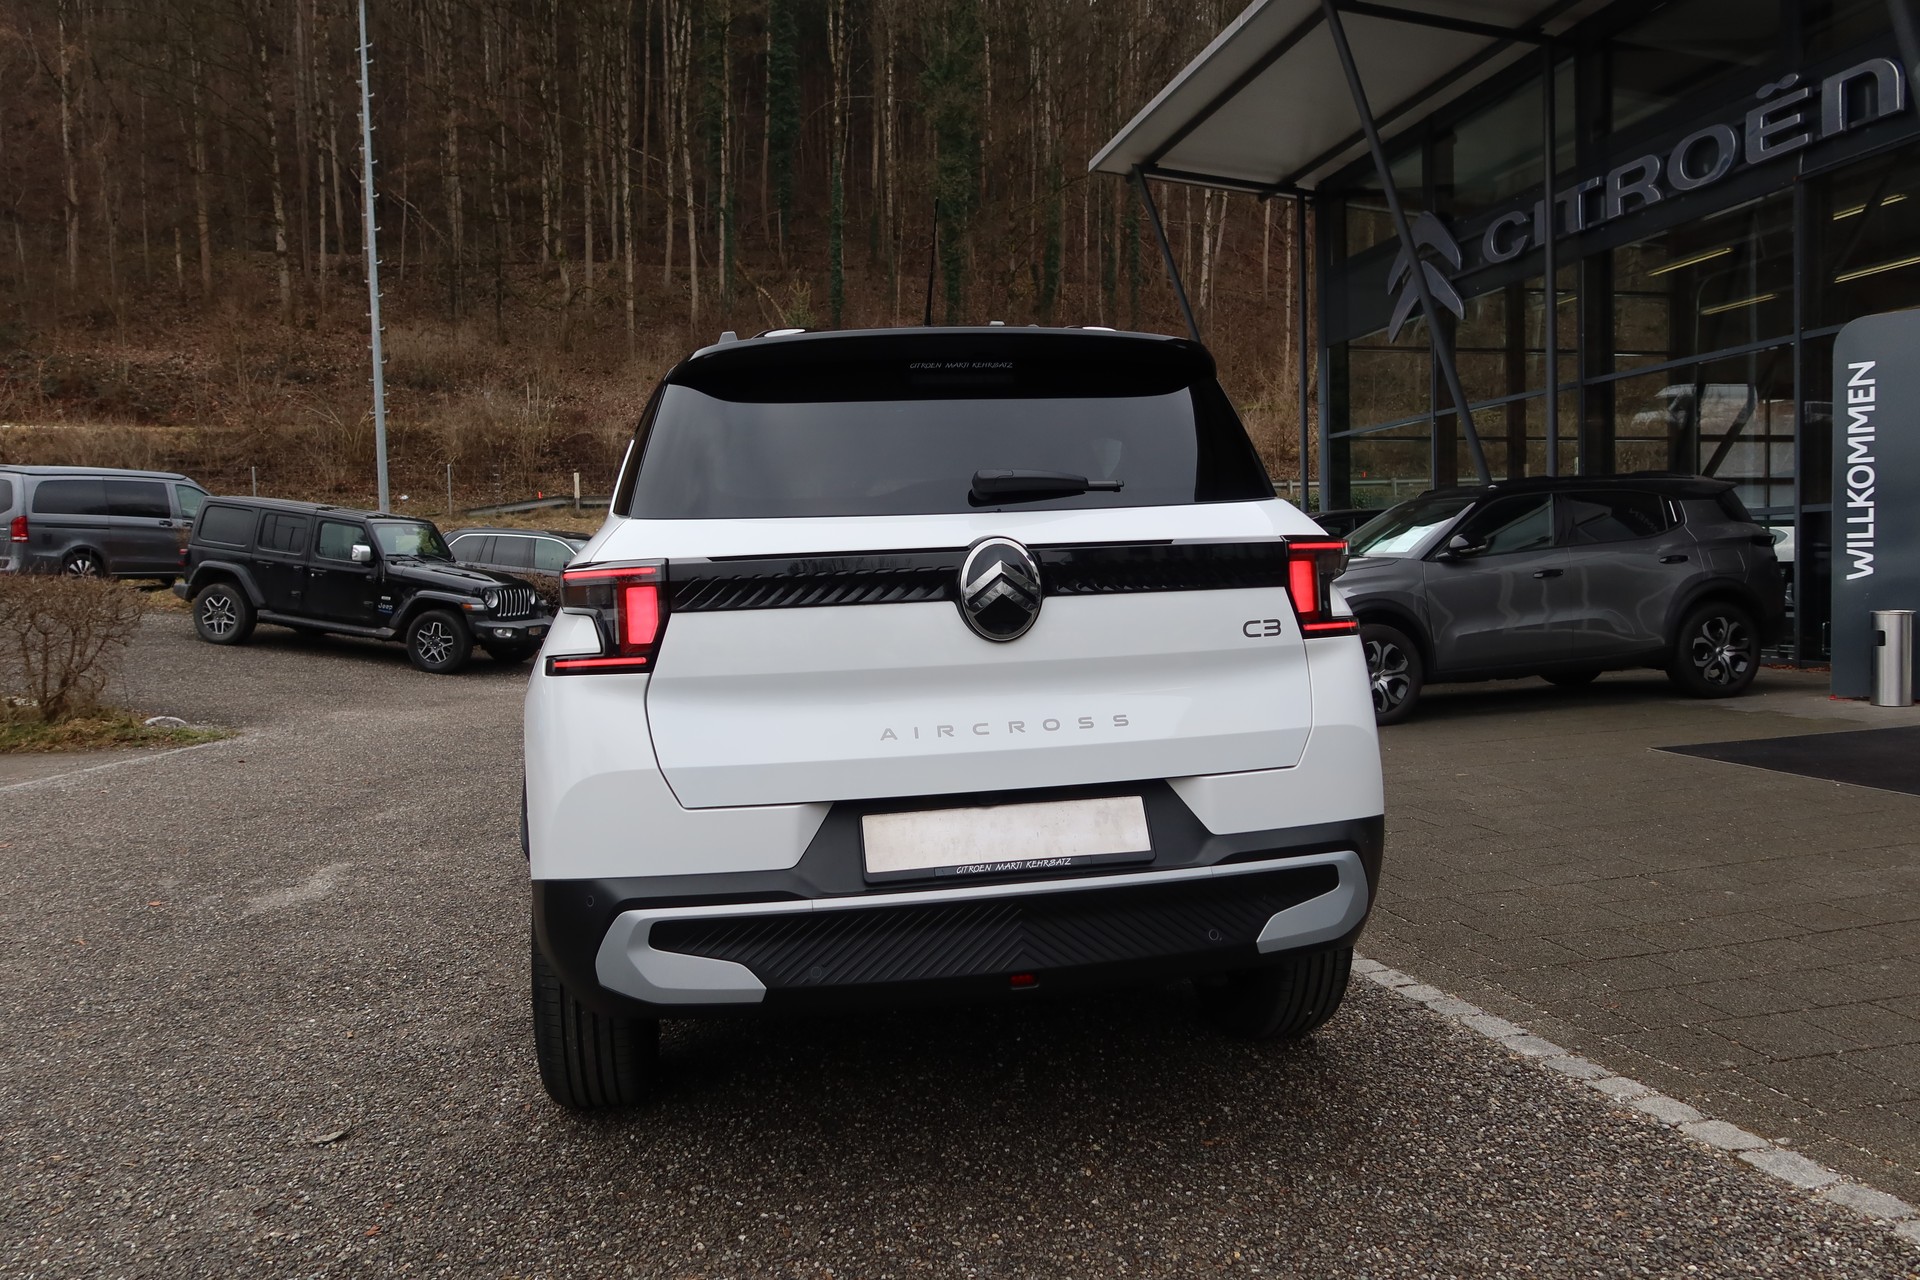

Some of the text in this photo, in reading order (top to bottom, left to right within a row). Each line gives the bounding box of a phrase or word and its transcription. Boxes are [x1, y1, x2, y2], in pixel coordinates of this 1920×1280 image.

[1846, 360, 1876, 580] WILLKOMMEN
[1243, 619, 1281, 637] C3
[880, 714, 1129, 740] AIRCROSS
[956, 864, 992, 874] CITROEN
[995, 862, 1022, 871] MARTI
